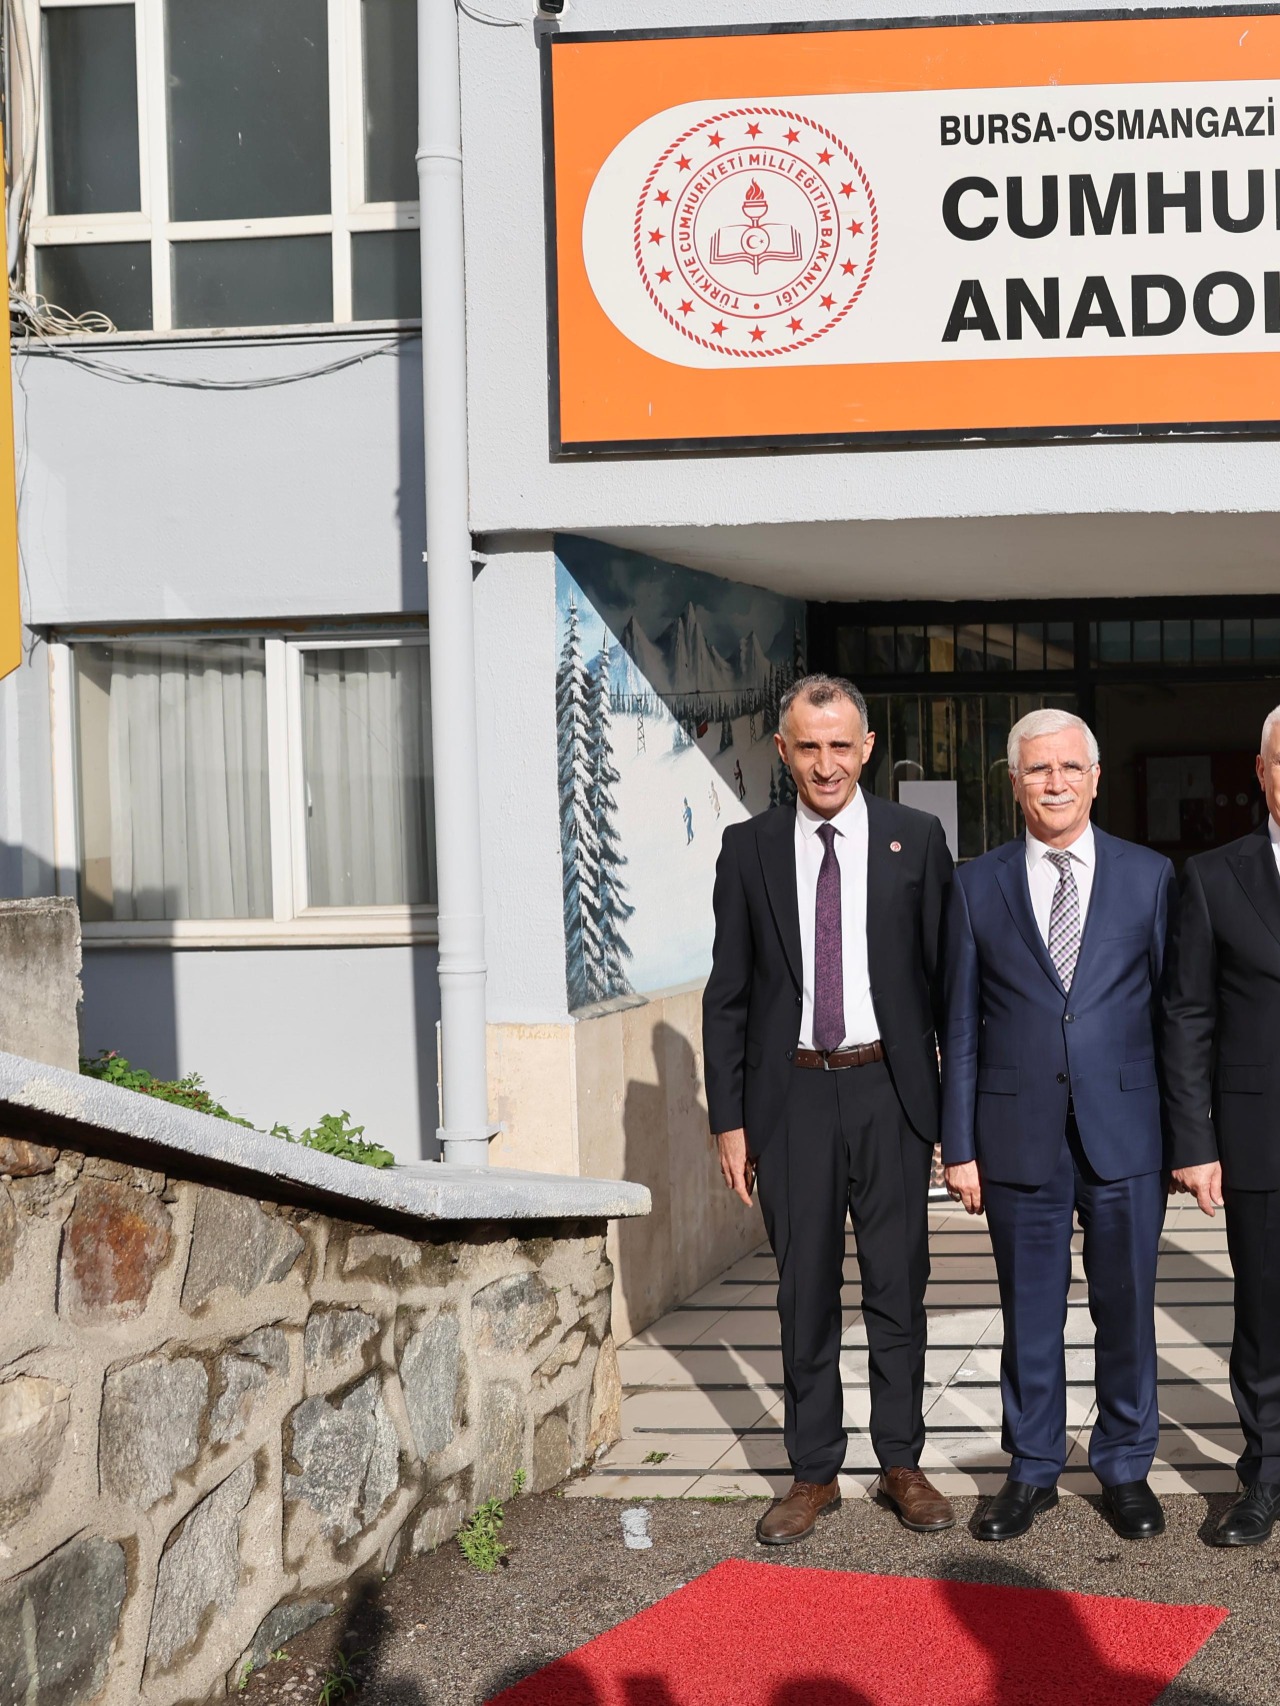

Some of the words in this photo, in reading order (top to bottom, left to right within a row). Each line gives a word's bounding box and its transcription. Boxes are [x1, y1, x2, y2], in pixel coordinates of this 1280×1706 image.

[940, 97, 1275, 146] BURSA-OSMANGAZİ
[749, 151, 797, 175] MİLLÎ
[679, 152, 743, 253] CUMHURİYETİ
[795, 169, 832, 222] EĞİTİM
[684, 257, 740, 310] TÜRKİYE
[776, 228, 833, 307] BAKANLIĞI
